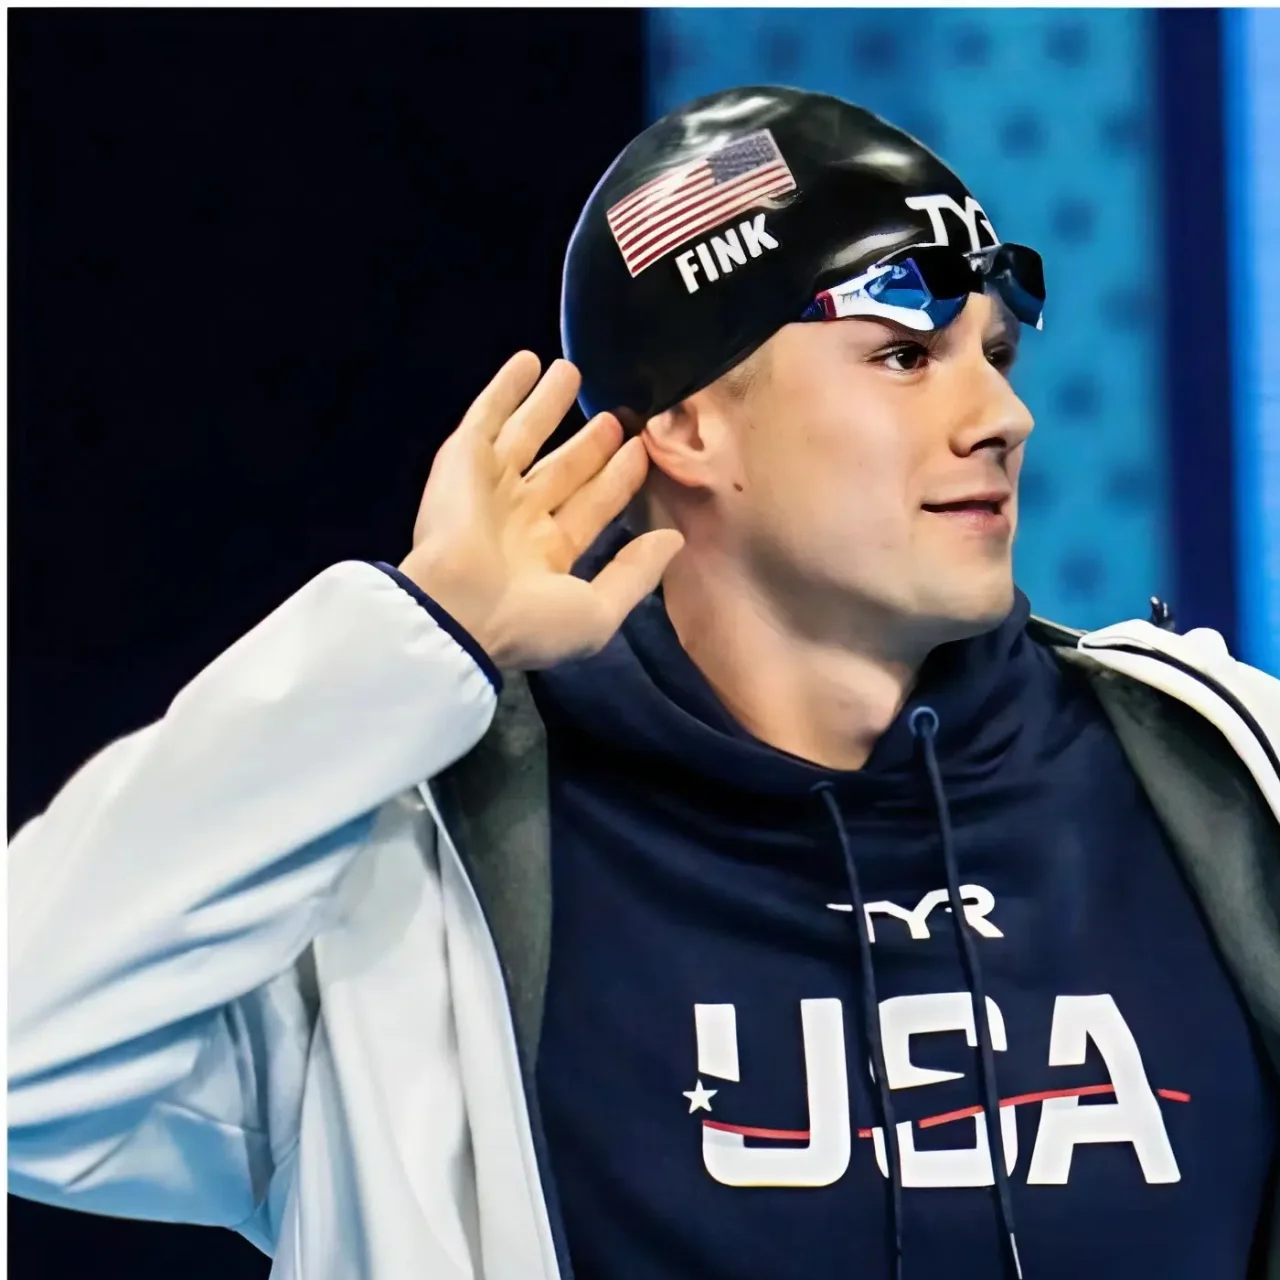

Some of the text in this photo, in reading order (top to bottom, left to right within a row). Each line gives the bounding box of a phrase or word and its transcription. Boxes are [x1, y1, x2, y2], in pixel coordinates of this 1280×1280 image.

[674, 212, 780, 295] FINK
[826, 883, 1005, 943] TYR
[693, 991, 1182, 1188] USA
